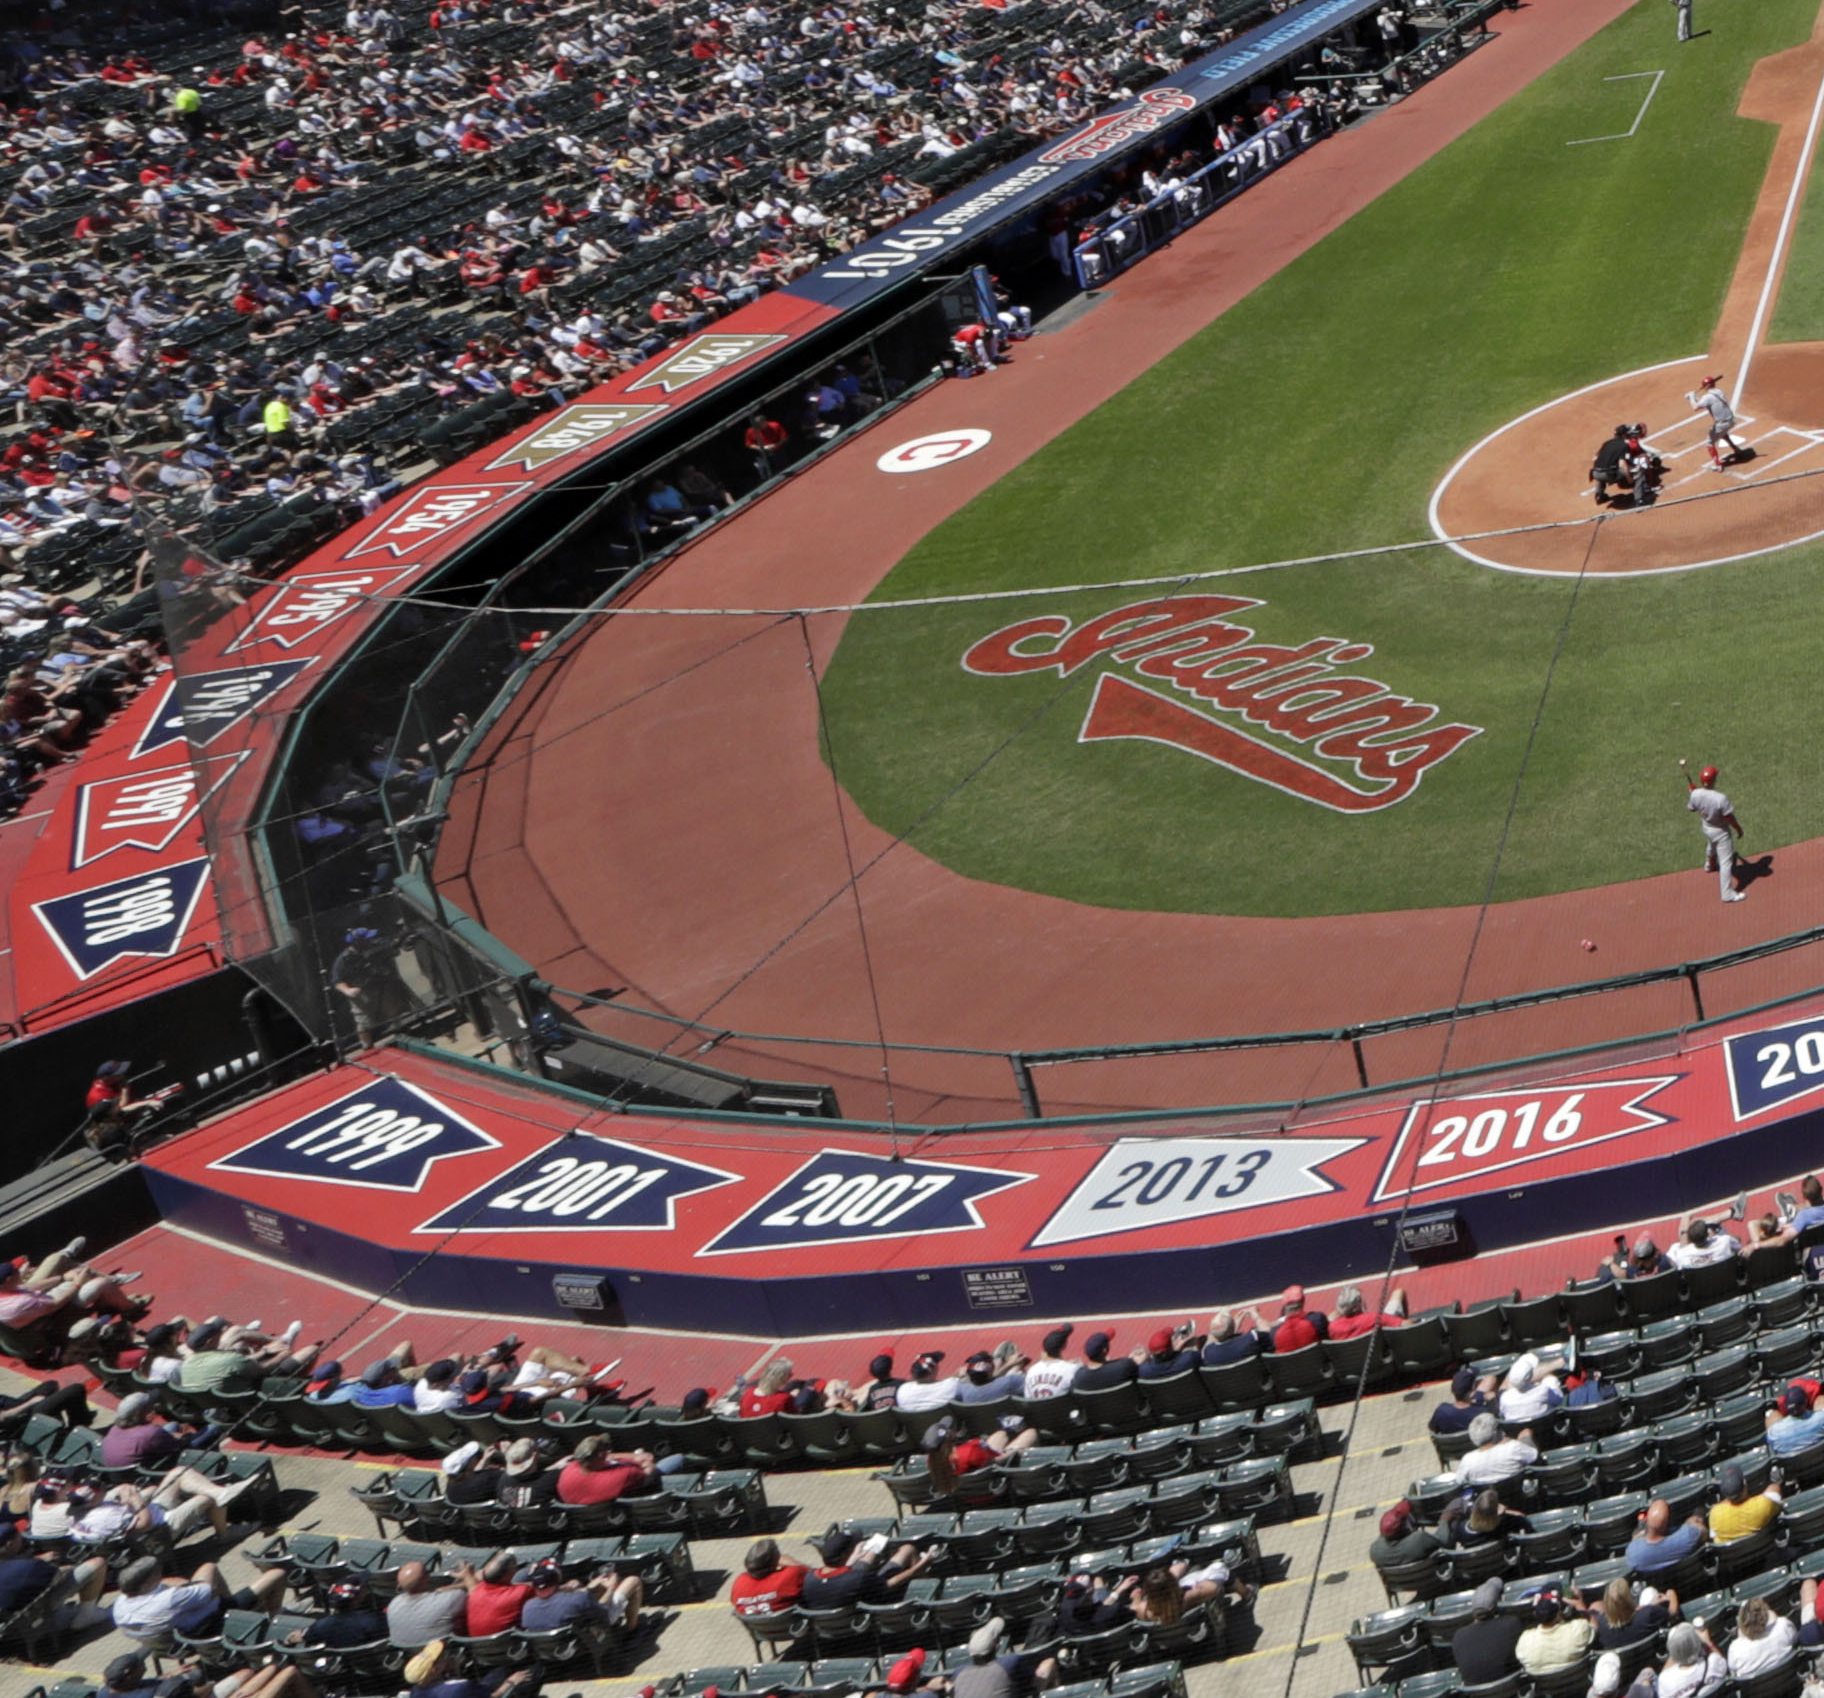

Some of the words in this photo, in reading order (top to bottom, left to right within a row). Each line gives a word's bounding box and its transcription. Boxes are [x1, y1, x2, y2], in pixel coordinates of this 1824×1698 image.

[822, 227, 948, 280] 1901
[668, 334, 754, 376] 1920
[549, 409, 629, 452] 1948
[400, 485, 494, 540] 1954
[267, 575, 374, 627] 1995
[961, 594, 1484, 813] Indians
[100, 770, 199, 831] 1997
[84, 877, 176, 945] 1998
[282, 1101, 448, 1172] 1999
[1428, 1093, 1584, 1167] 2016
[486, 1157, 670, 1223] 2001
[766, 1171, 954, 1229] 2007
[1089, 1148, 1274, 1213] 2013
[985, 1270, 1021, 1281] ALERT
